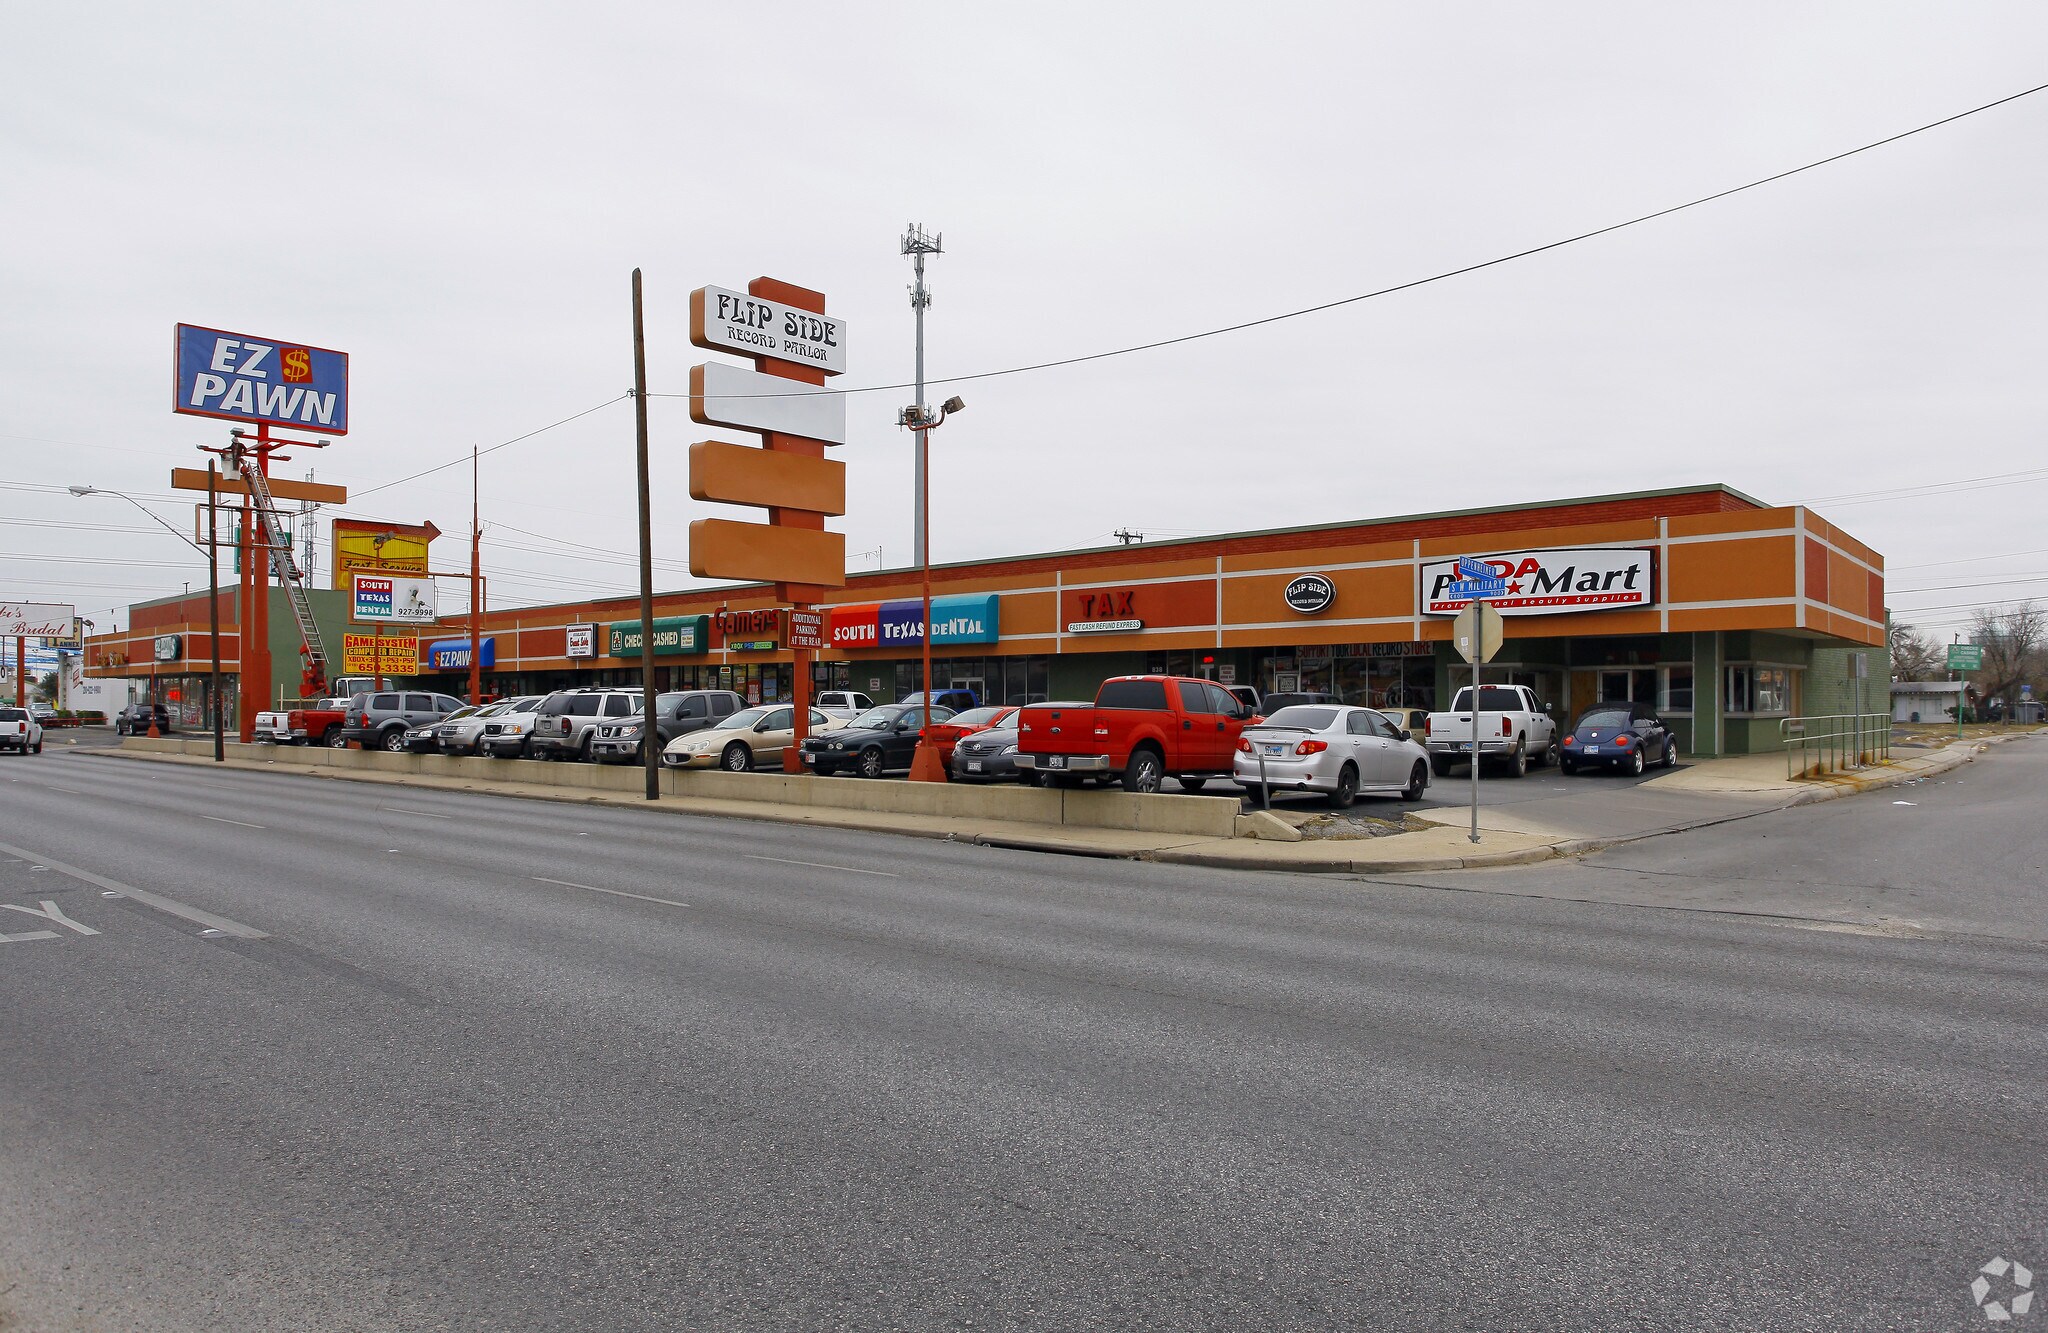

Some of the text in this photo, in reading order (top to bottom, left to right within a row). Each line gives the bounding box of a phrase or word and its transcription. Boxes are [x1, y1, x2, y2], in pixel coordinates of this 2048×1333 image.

[717, 294, 837, 347] FLIP SIDE
[727, 326, 828, 361] RECORD PARLOR
[210, 337, 273, 378] EZ
[190, 372, 336, 425] PAWN
[1461, 556, 1497, 578] OPPENHEIMER
[360, 580, 390, 589] SOUTH
[1451, 580, 1503, 592] S W MILITARY
[1530, 563, 1641, 594] Mart
[1288, 582, 1327, 597] FLIP SIDE
[360, 593, 390, 602] TEXAS
[1079, 591, 1134, 617] TAX
[1434, 600, 1514, 609] Profenal
[1576, 594, 1637, 603] Supplies
[356, 605, 433, 616] DENTAL 927-9998
[714, 607, 779, 634] Gamers
[792, 613, 821, 625] ADDITIONAL
[1069, 620, 1140, 631] FAST CASH REFUND EXPRESS
[10, 621, 65, 635] Bridal
[796, 625, 817, 635] PARKING
[833, 617, 984, 641] SOUTH TEXAS DENTAL
[345, 635, 417, 650] GAME SYSTEM
[624, 634, 642, 649] CHEC
[653, 631, 678, 647] CASHED
[791, 636, 821, 647] AT THE REAR
[348, 648, 414, 657] COMPUER REPAIR
[1297, 644, 1330, 658] SUPPORT
[1331, 643, 1349, 657] YOUR
[1349, 643, 1372, 657] LOCAL
[1372, 642, 1402, 656] RECORD
